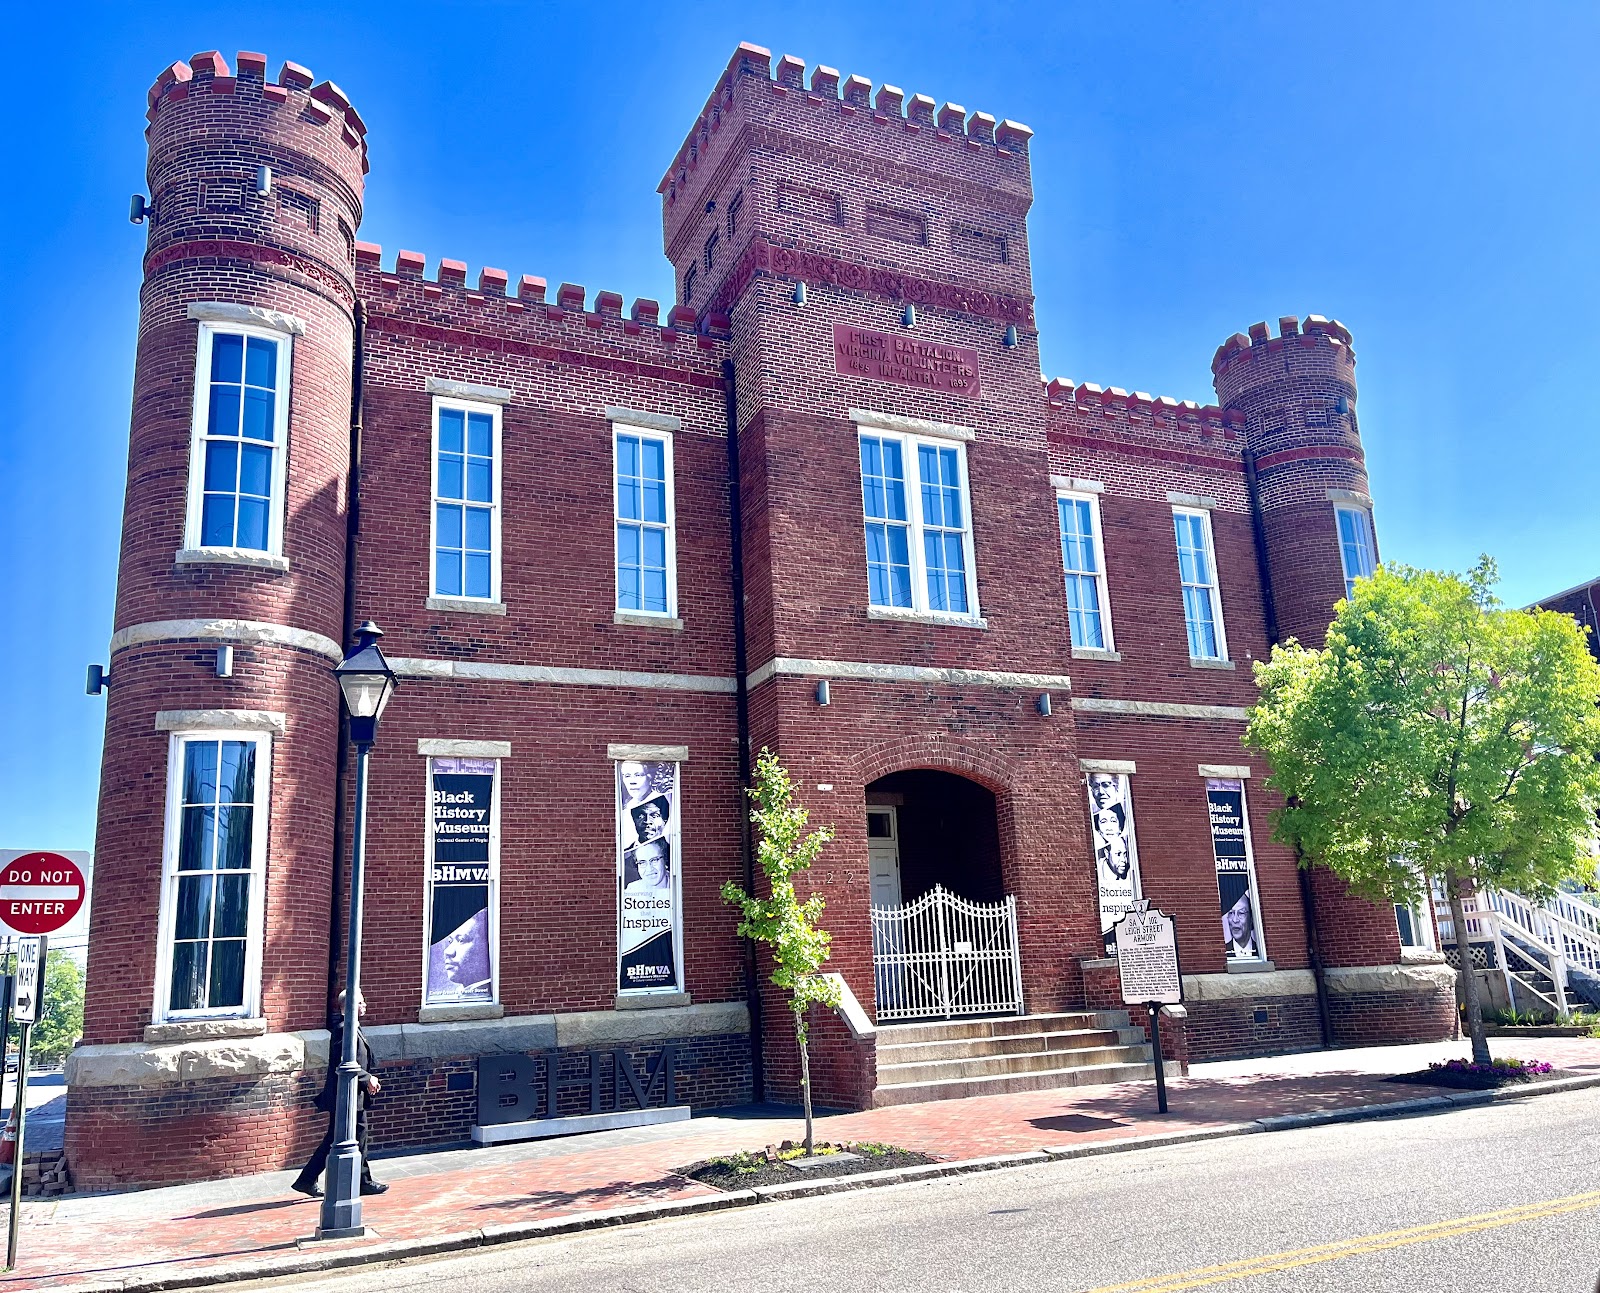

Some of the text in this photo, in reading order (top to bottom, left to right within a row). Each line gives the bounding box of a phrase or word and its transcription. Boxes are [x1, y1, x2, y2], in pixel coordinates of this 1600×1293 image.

[850, 331, 887, 348] FIRST
[839, 342, 892, 363] VIRGINIA
[850, 359, 968, 388] 1895 INFANTRY. 1895
[433, 790, 474, 803] Black
[434, 806, 486, 822] History
[1209, 803, 1233, 813] Black
[1210, 814, 1240, 826] History
[9, 871, 73, 883] DO NOT
[1100, 886, 1132, 898] Stories
[10, 902, 65, 915] ENTER
[624, 896, 671, 910] Stories
[623, 915, 672, 932] Inspire.
[1129, 918, 1137, 927] SA
[1142, 924, 1163, 934] STREET
[1133, 933, 1157, 942] ARMORY
[21, 944, 36, 963] ONE
[19, 967, 35, 986] WAY
[626, 964, 670, 977] BHMVA
[478, 1043, 688, 1127] BHM
